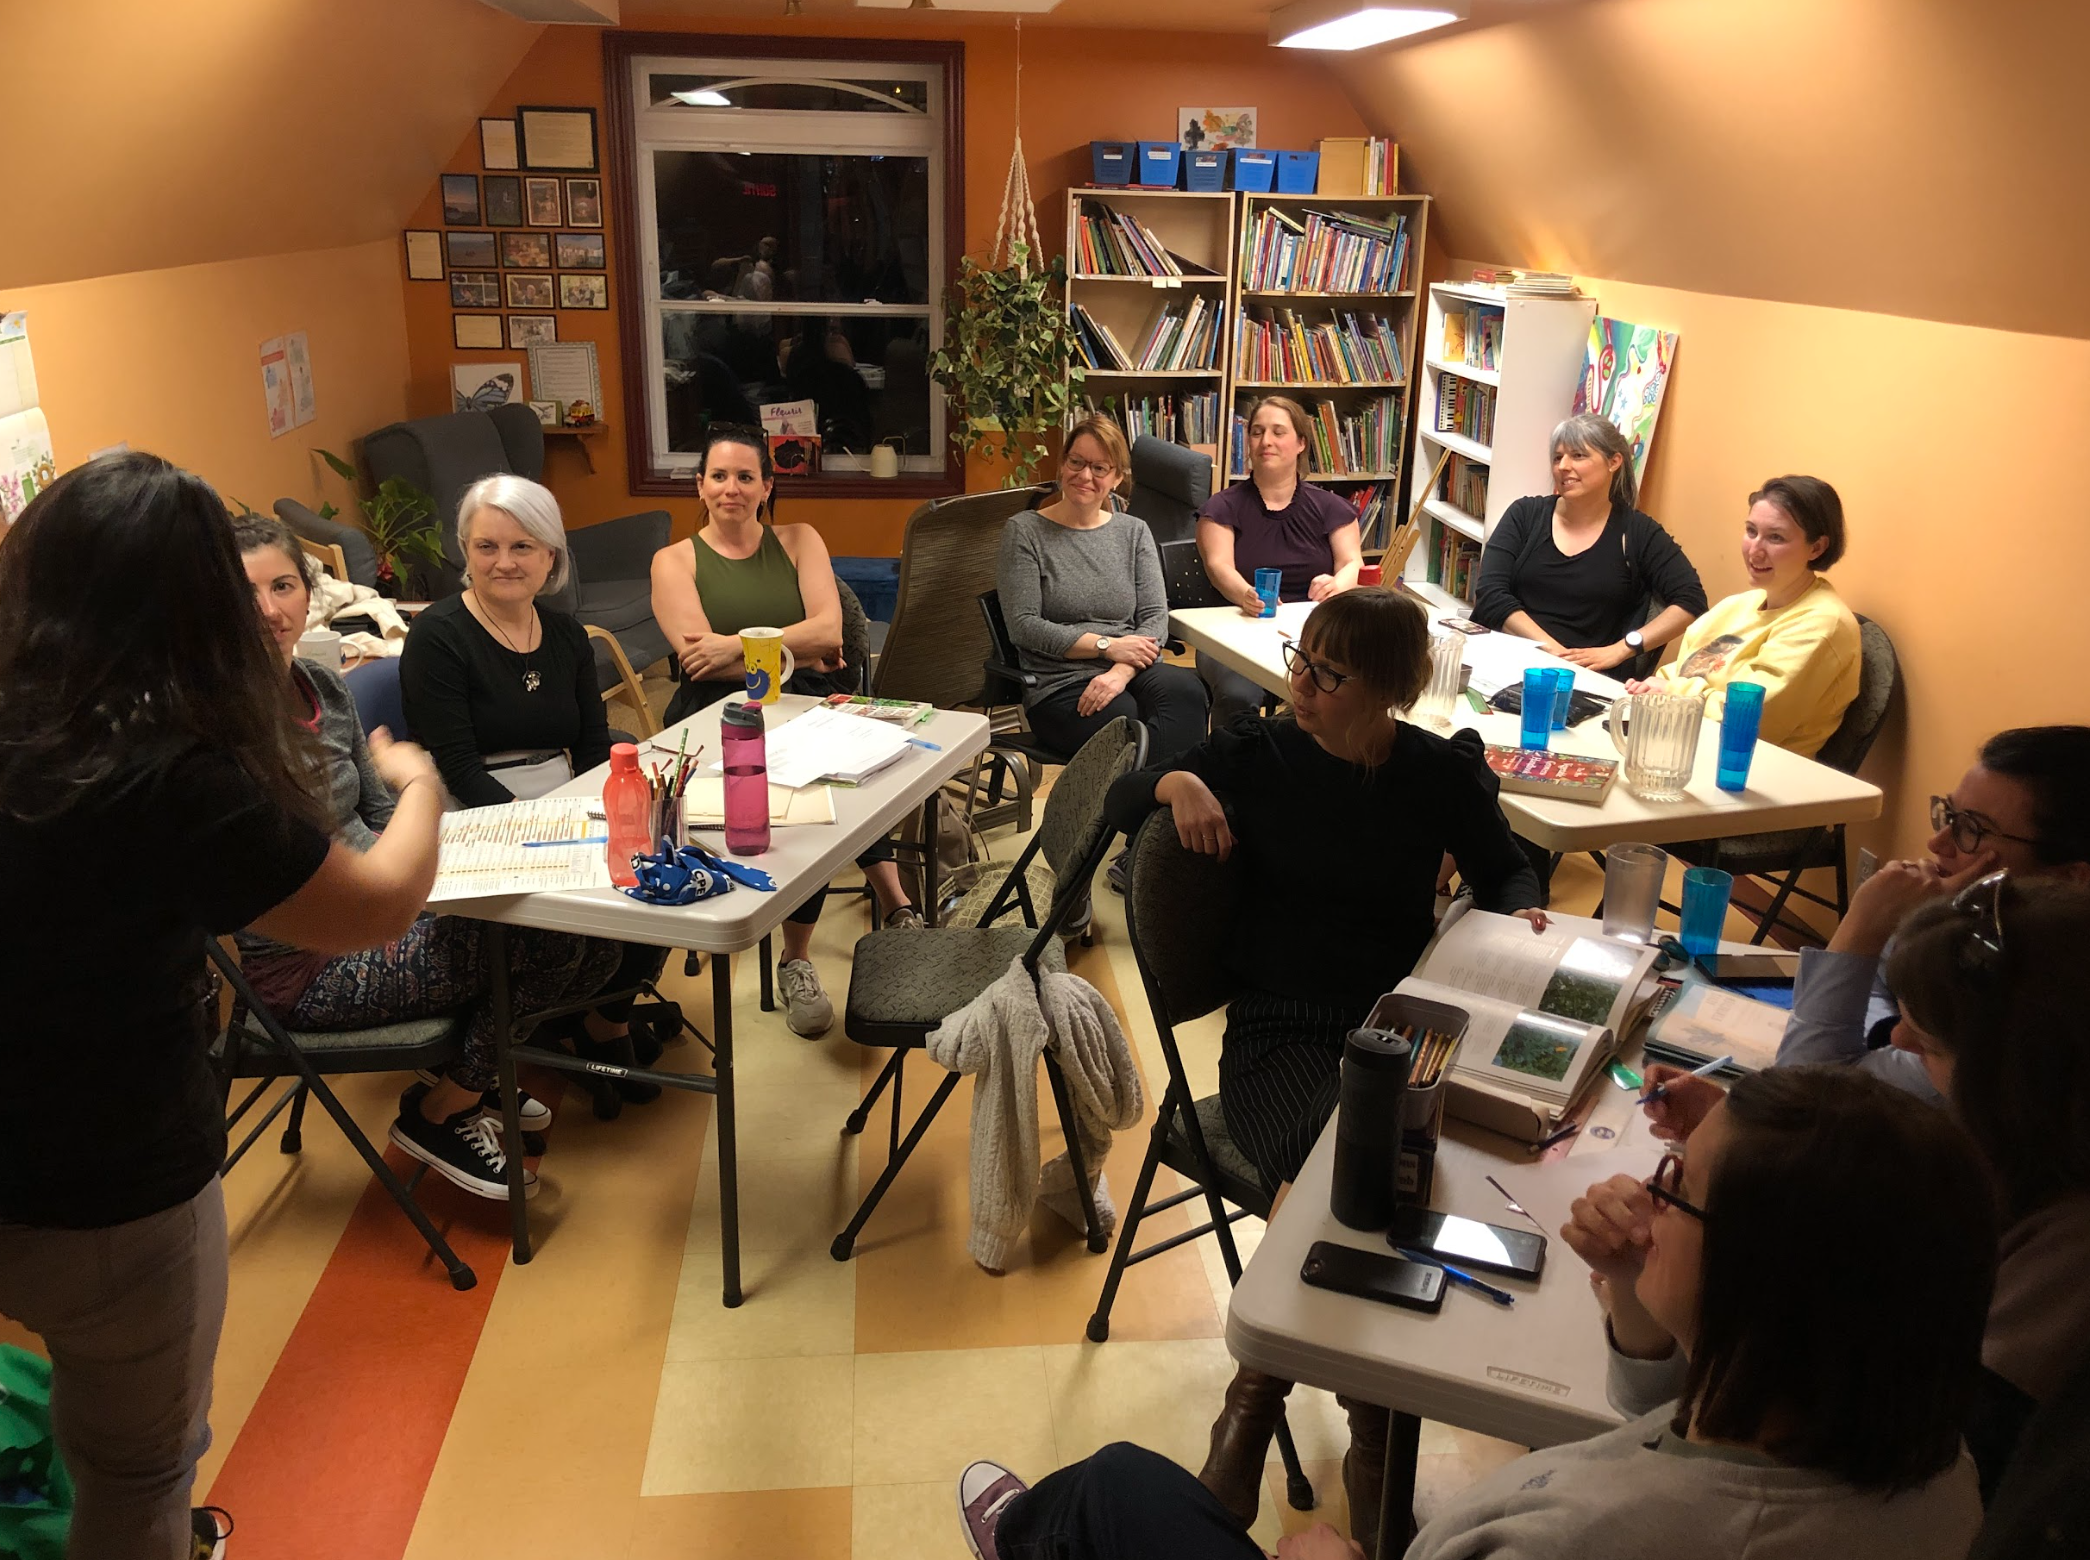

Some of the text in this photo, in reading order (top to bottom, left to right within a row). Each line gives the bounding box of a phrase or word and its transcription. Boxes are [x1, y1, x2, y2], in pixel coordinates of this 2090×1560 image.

[694, 870, 707, 896] CPE
[591, 1064, 622, 1074] LIFETIME
[1496, 1371, 1562, 1395] LIFETIME
